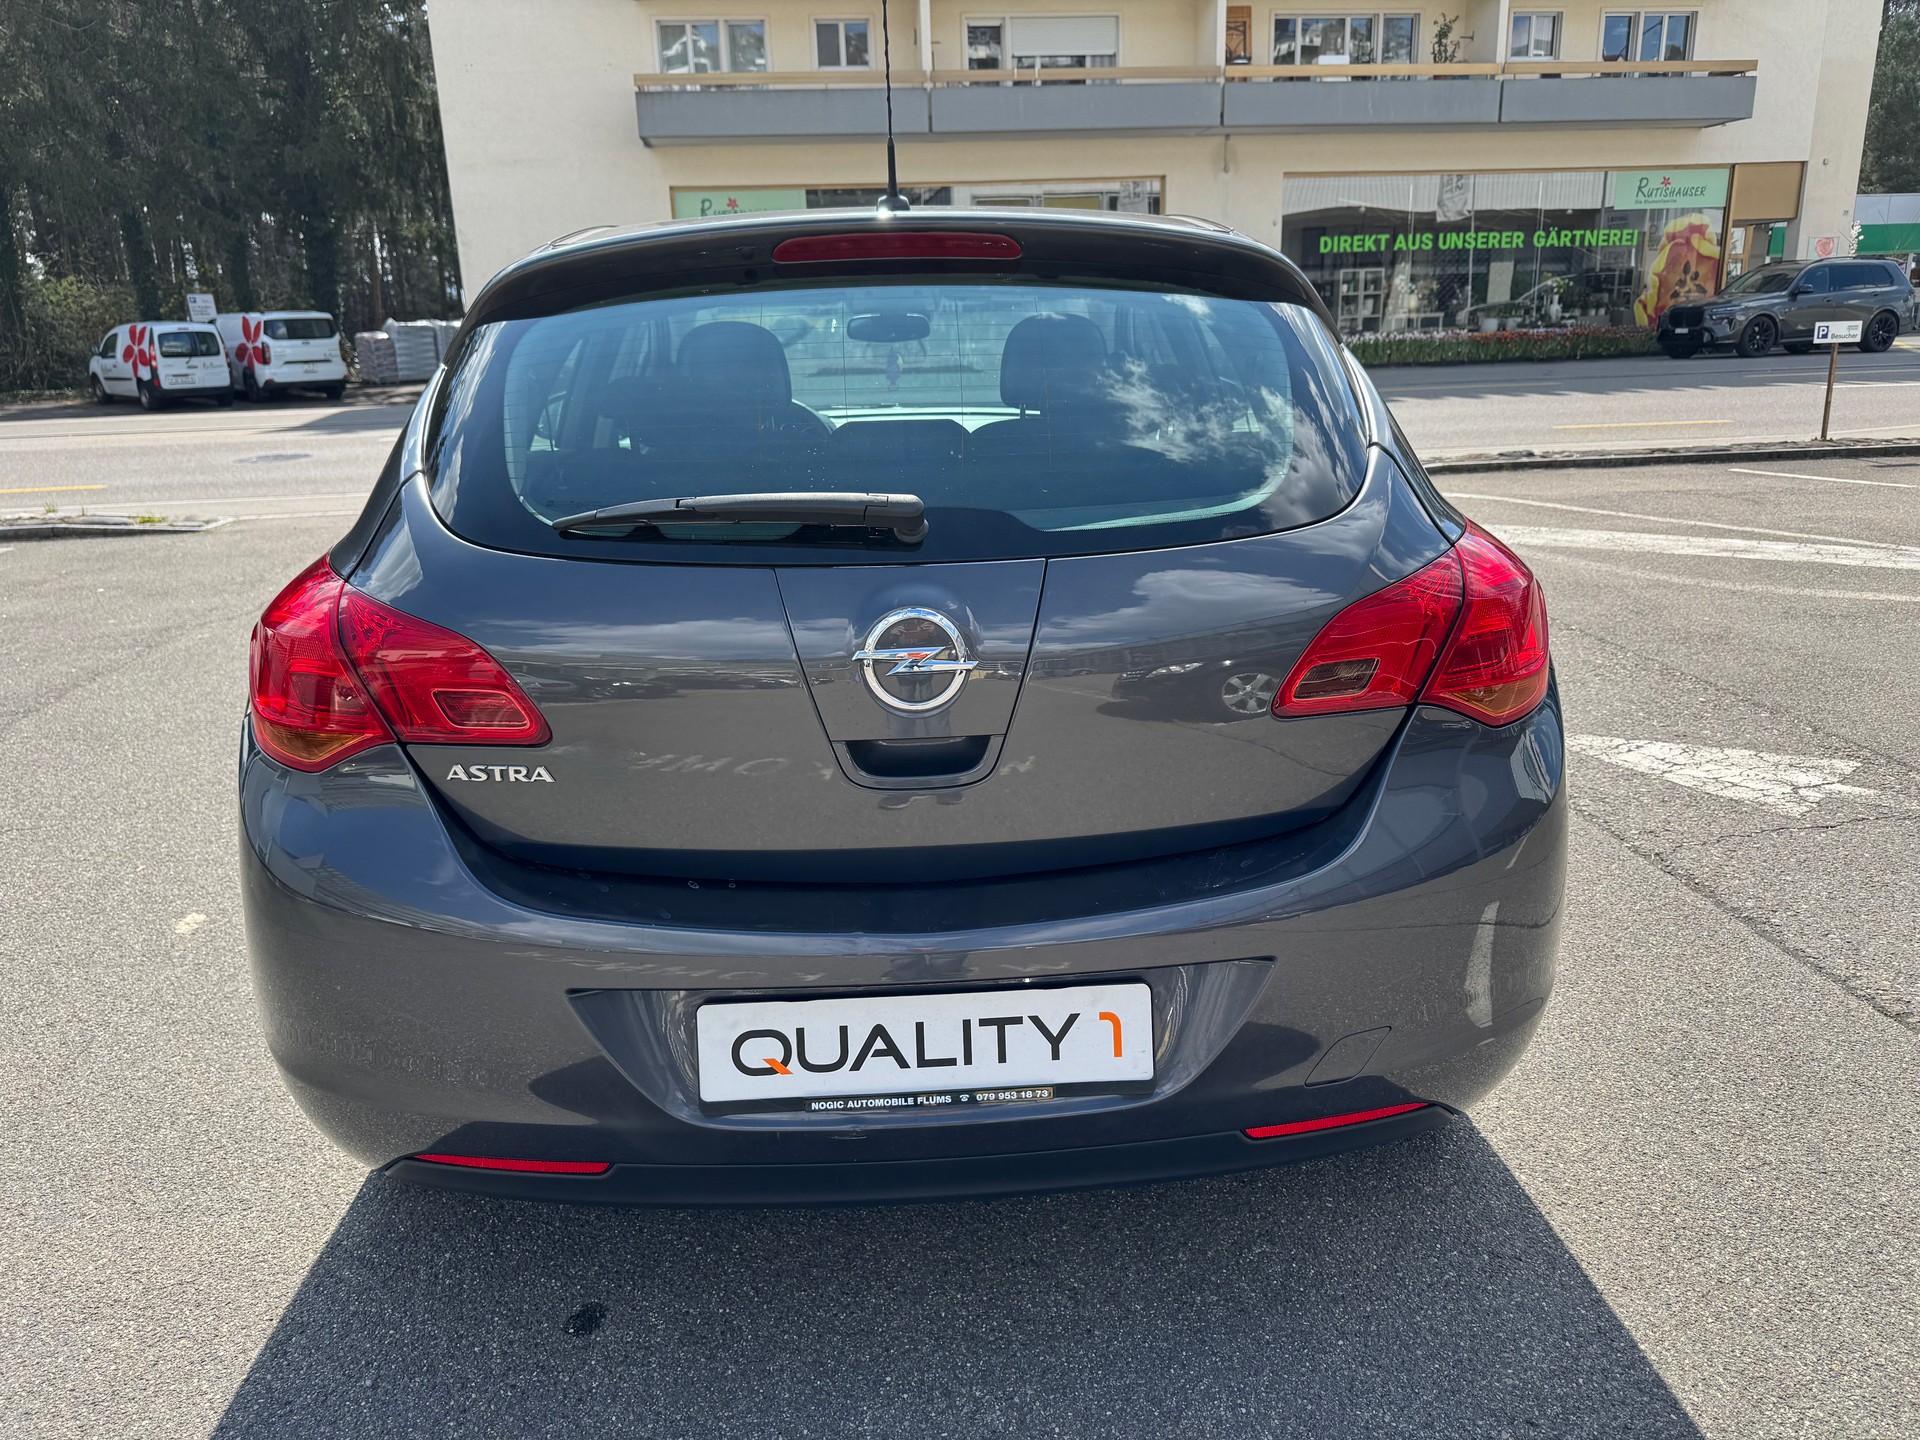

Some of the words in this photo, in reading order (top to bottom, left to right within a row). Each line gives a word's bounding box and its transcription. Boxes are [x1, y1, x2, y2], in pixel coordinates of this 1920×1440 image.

[1319, 235, 1389, 253] DIREKT
[1393, 234, 1433, 251] AUS
[1438, 231, 1525, 250] UNSERER
[1532, 227, 1639, 248] GÄRTNEREI
[1830, 332, 1858, 340] Besucher
[446, 764, 556, 783] ASTRA
[811, 1101, 845, 1110] NOGIC
[847, 1097, 915, 1109] AUTOMOBILE
[917, 1095, 952, 1105] FLUMS
[976, 1093, 996, 1101] 079
[998, 1092, 1017, 1100] 953
[1020, 1091, 1033, 1099] 18
[1035, 1090, 1049, 1098] 73
